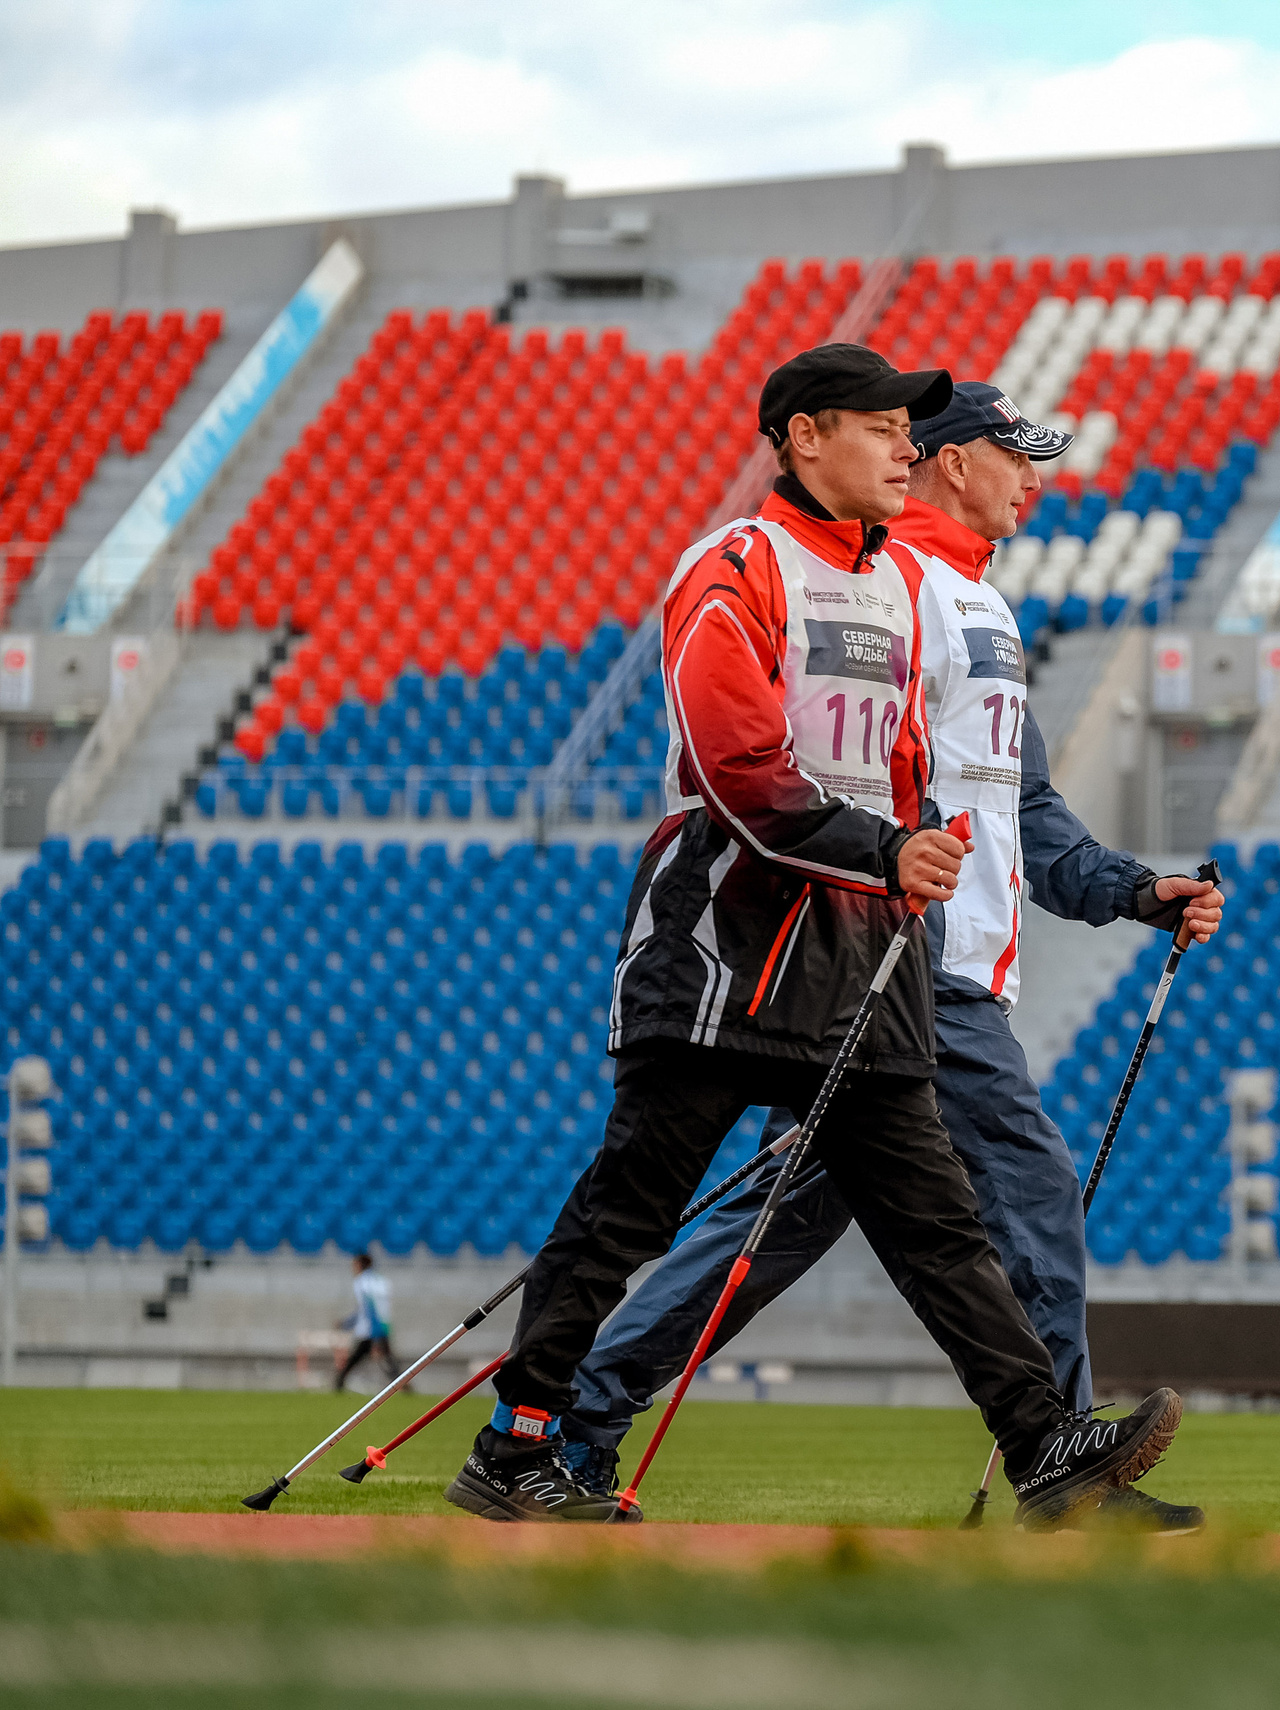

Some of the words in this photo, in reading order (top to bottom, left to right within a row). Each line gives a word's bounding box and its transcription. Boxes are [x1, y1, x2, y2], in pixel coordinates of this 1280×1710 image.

[842, 630, 892, 650] СЕВЕРНАЯ
[826, 693, 898, 768] 110
[838, 1006, 867, 1058] НОВЫЙ
[1126, 1036, 1147, 1084] НОВЫЙ
[809, 1068, 836, 1116] ОБРАЗ
[1106, 1092, 1127, 1136] ОБРАЗ
[779, 1125, 808, 1177] ЖИЗНИ
[1088, 1144, 1109, 1190] ЖИЗНИ
[518, 1421, 540, 1435] 110
